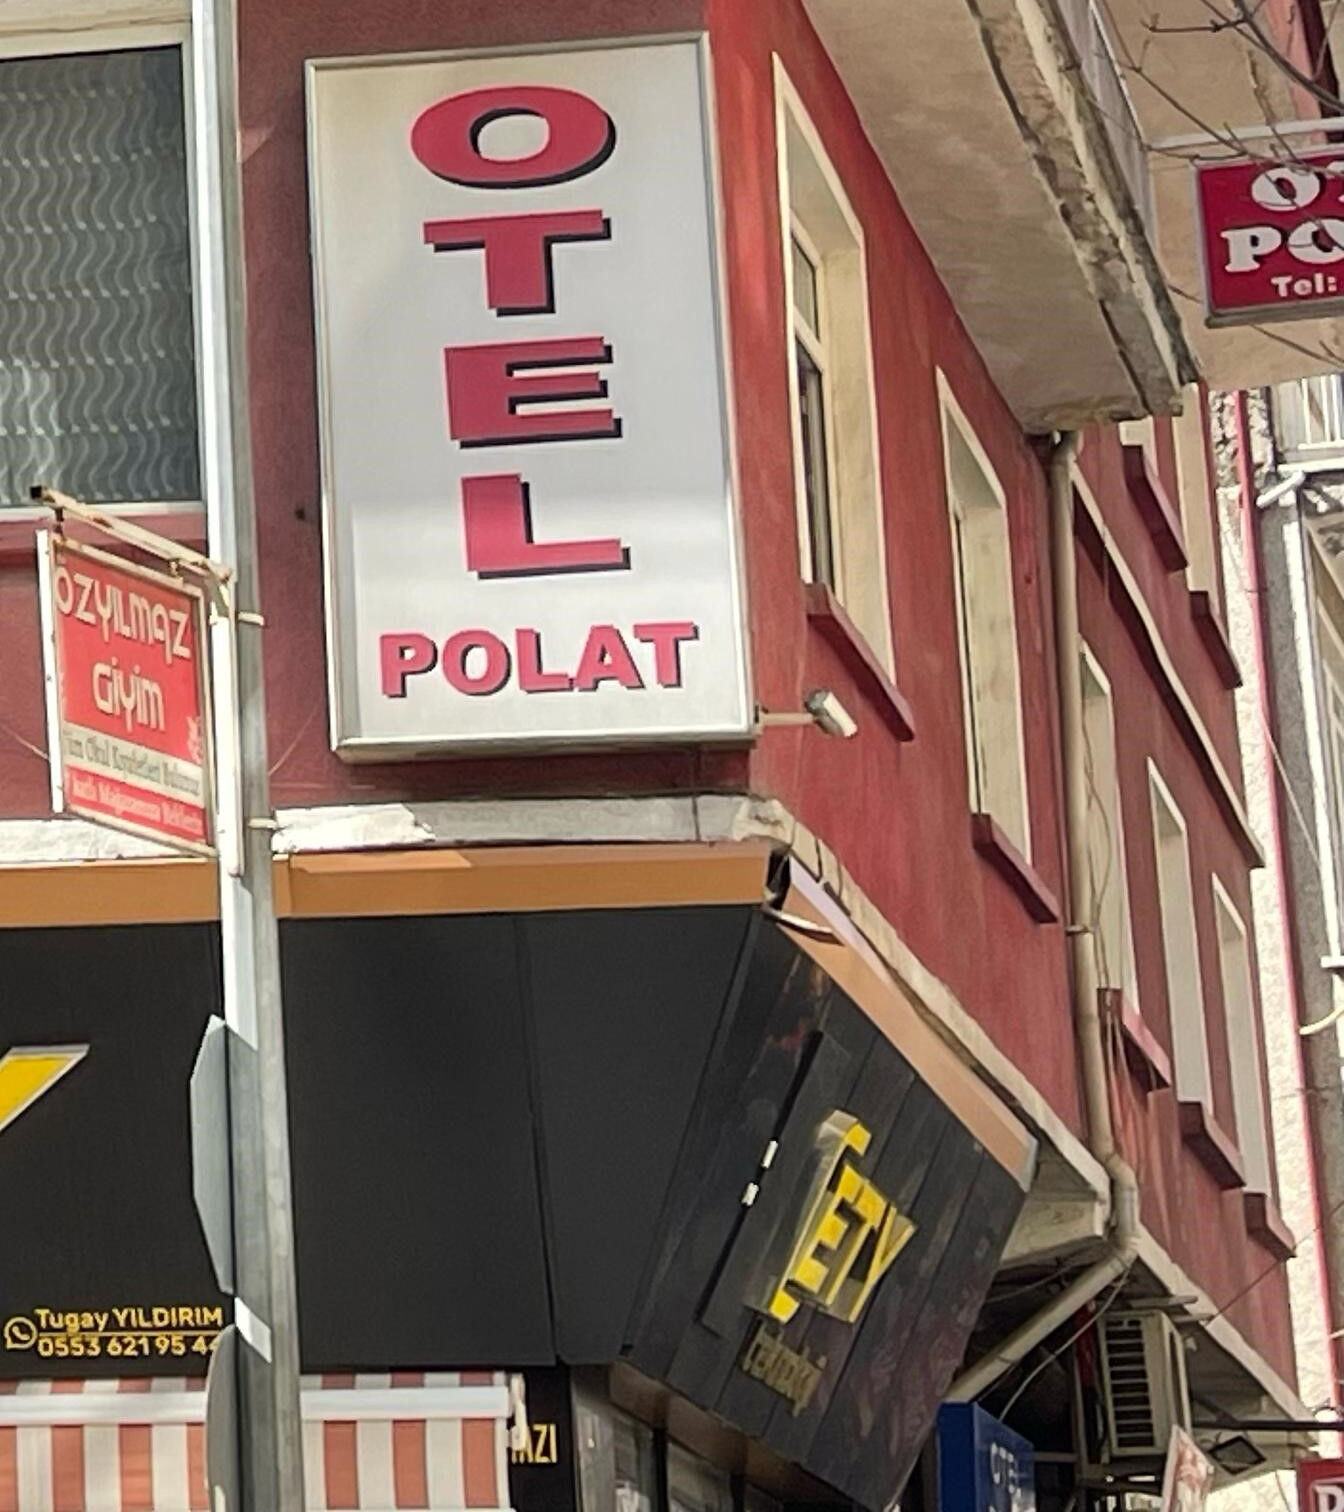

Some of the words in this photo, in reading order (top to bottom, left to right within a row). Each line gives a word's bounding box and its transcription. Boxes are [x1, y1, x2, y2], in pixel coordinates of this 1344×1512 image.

[410, 84, 632, 580] OTEL
[378, 620, 700, 700] POLAT
[34, 1308, 109, 1333] Tugay
[112, 1306, 224, 1328] YILDIRIM
[37, 1336, 102, 1357] 0553
[106, 1336, 151, 1357] 621
[155, 1336, 186, 1356] 95
